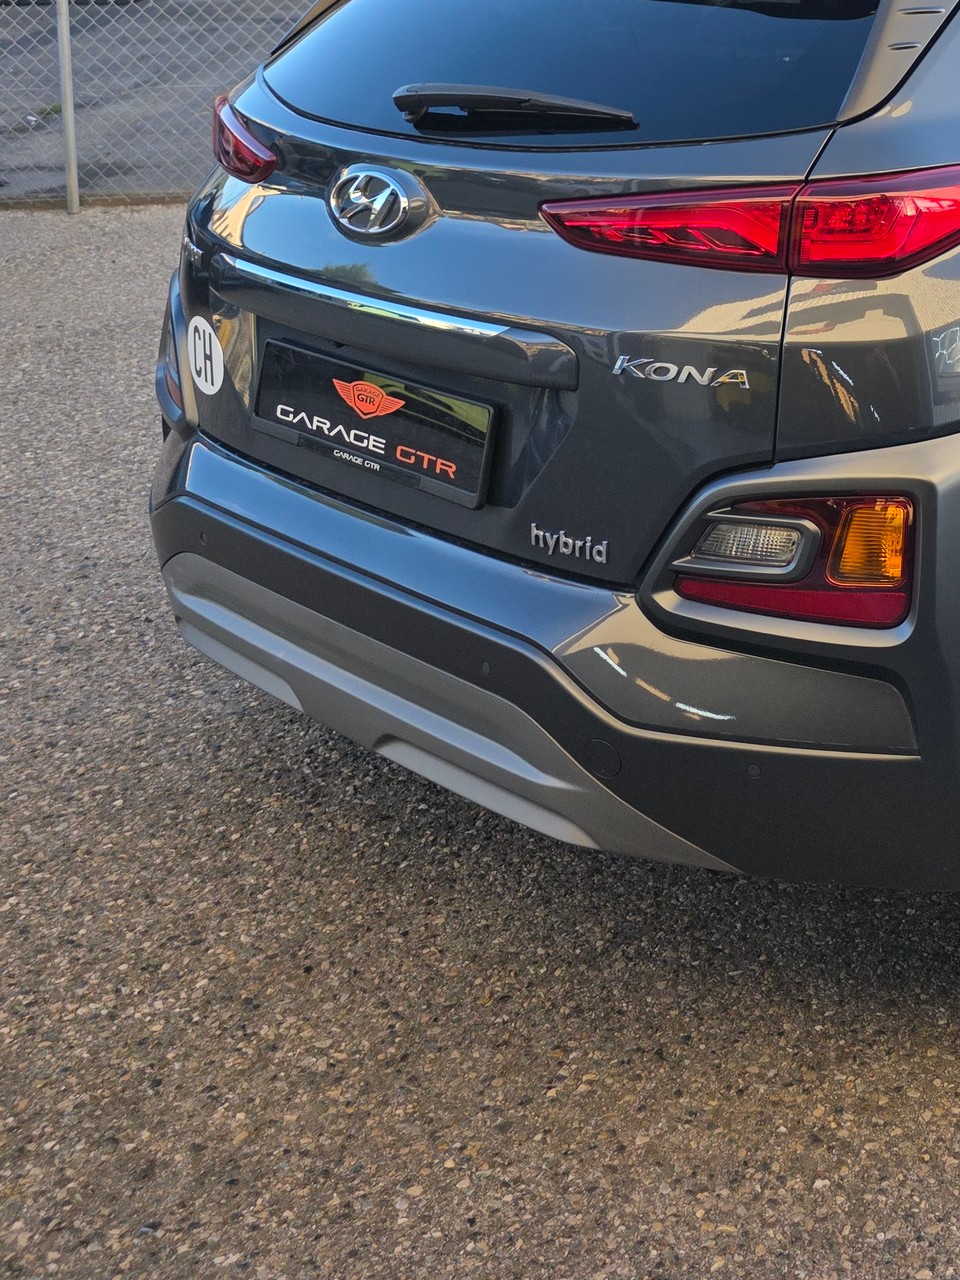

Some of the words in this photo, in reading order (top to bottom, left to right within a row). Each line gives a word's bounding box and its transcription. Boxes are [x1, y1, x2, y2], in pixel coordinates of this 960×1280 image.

[193, 324, 215, 387] CH
[611, 355, 750, 389] KONA
[356, 393, 376, 407] GTR
[275, 404, 386, 455] GARAGE
[395, 445, 457, 479] GTR
[333, 449, 363, 466] GARAGE
[364, 460, 380, 472] GTR
[530, 523, 608, 563] hybrid
